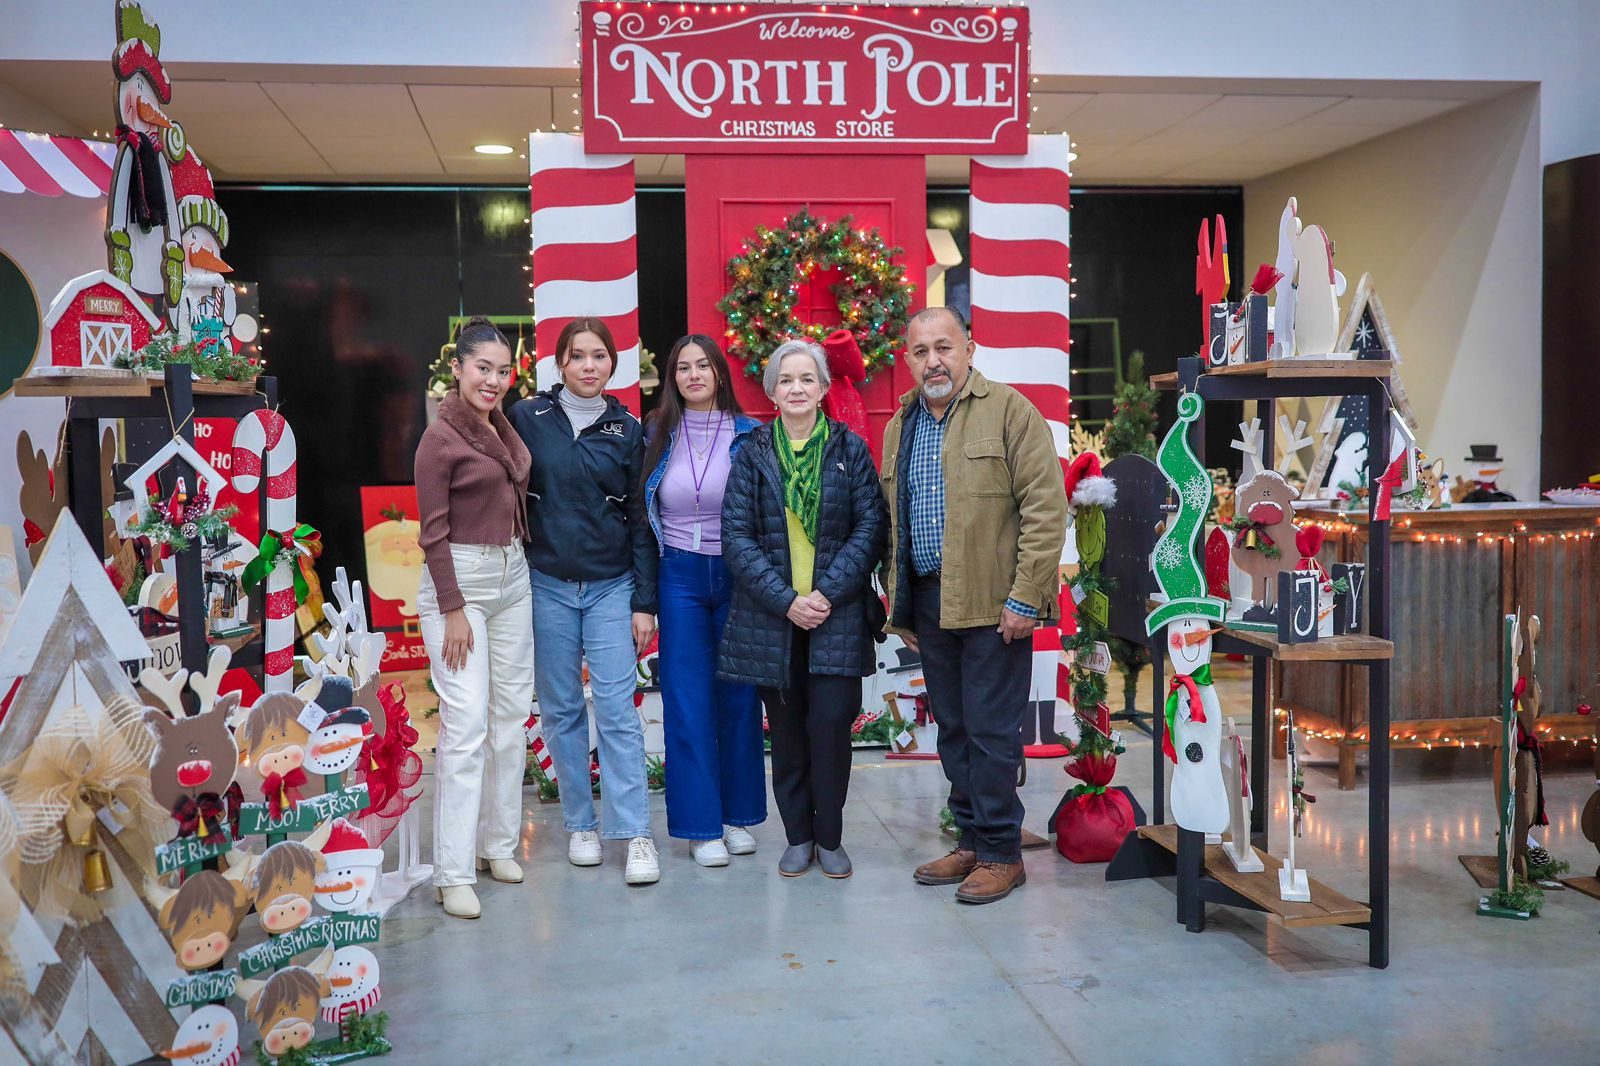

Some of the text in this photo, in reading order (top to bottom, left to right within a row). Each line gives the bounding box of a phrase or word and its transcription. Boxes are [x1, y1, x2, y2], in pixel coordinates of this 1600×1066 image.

[759, 19, 855, 41] Welcome
[609, 33, 1013, 120] NORTH POLE
[720, 119, 895, 137] CHRISTMAS STORE
[90, 299, 120, 314] MERRY
[210, 450, 232, 470] HO
[248, 925, 321, 973] CHRISTMAS
[168, 974, 236, 1007] CHRISTMAS
